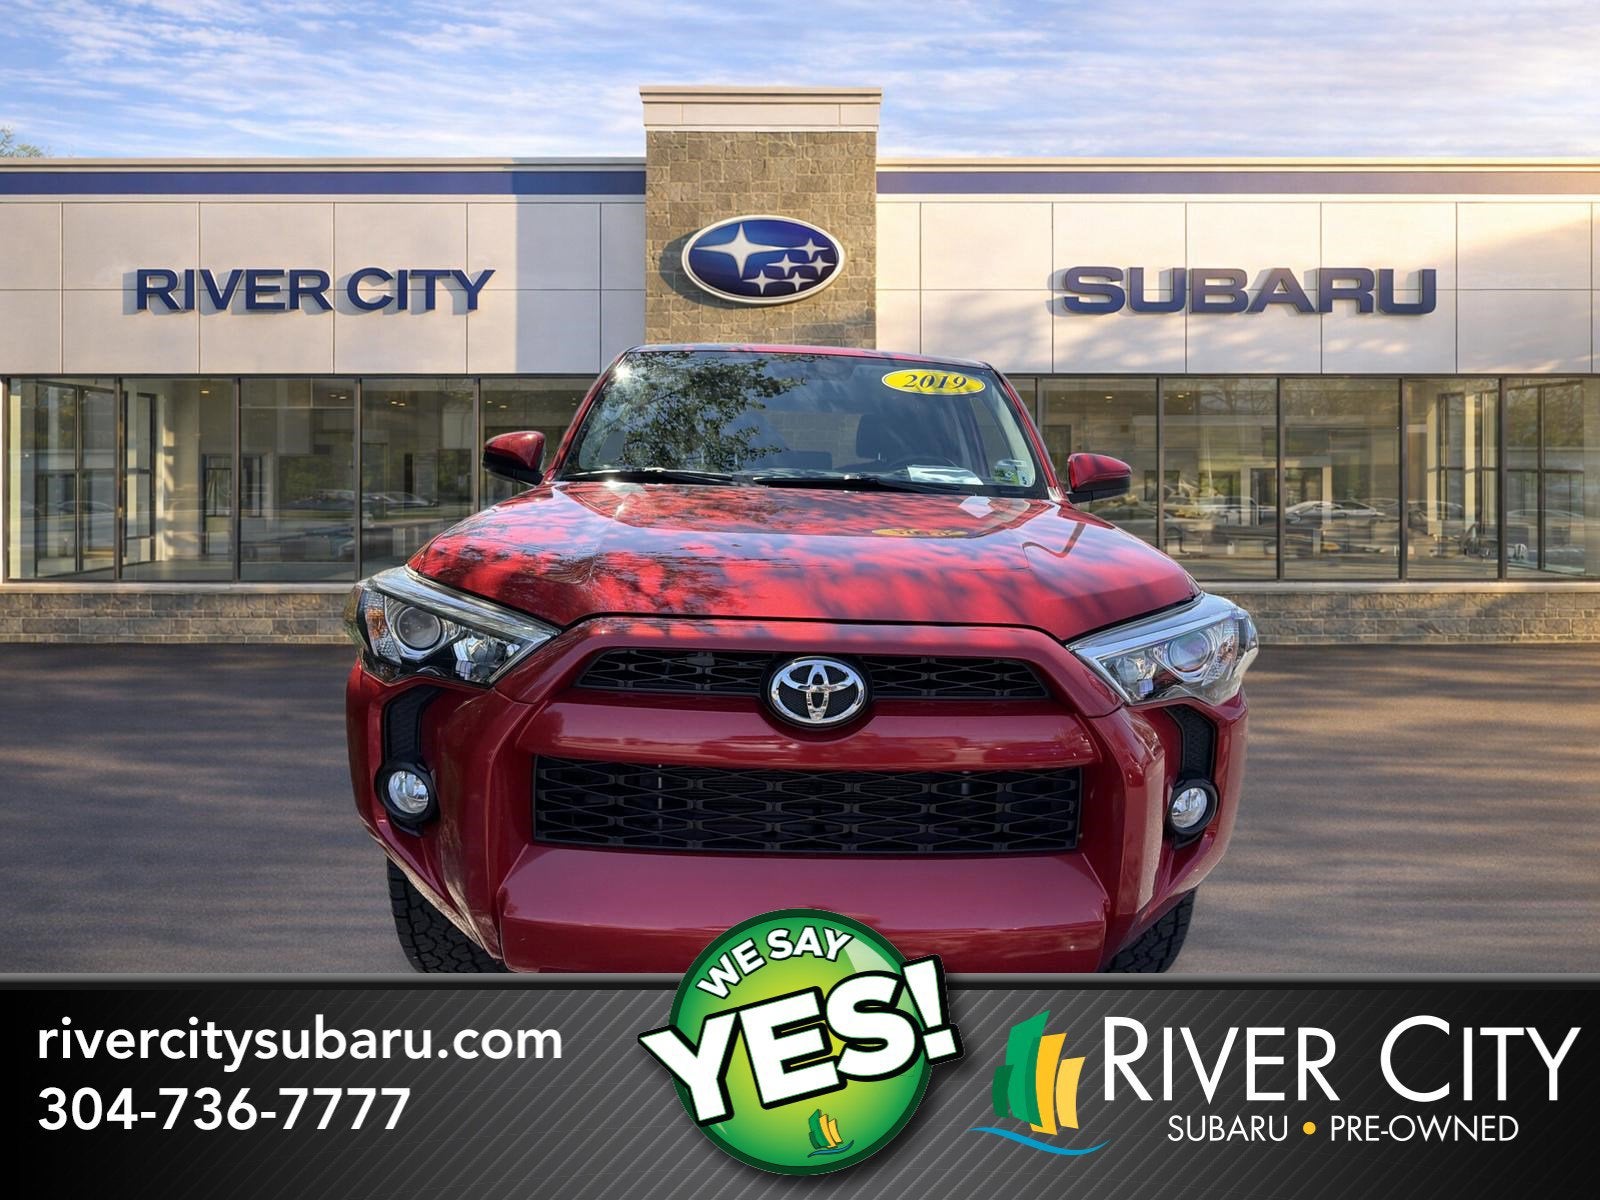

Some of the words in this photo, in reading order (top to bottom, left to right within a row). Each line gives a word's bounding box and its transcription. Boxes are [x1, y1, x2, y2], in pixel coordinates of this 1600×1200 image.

[136, 267, 335, 312] RIVER
[346, 266, 496, 312] CITY
[1063, 266, 1437, 315] SUBARU
[903, 374, 967, 389] 2019
